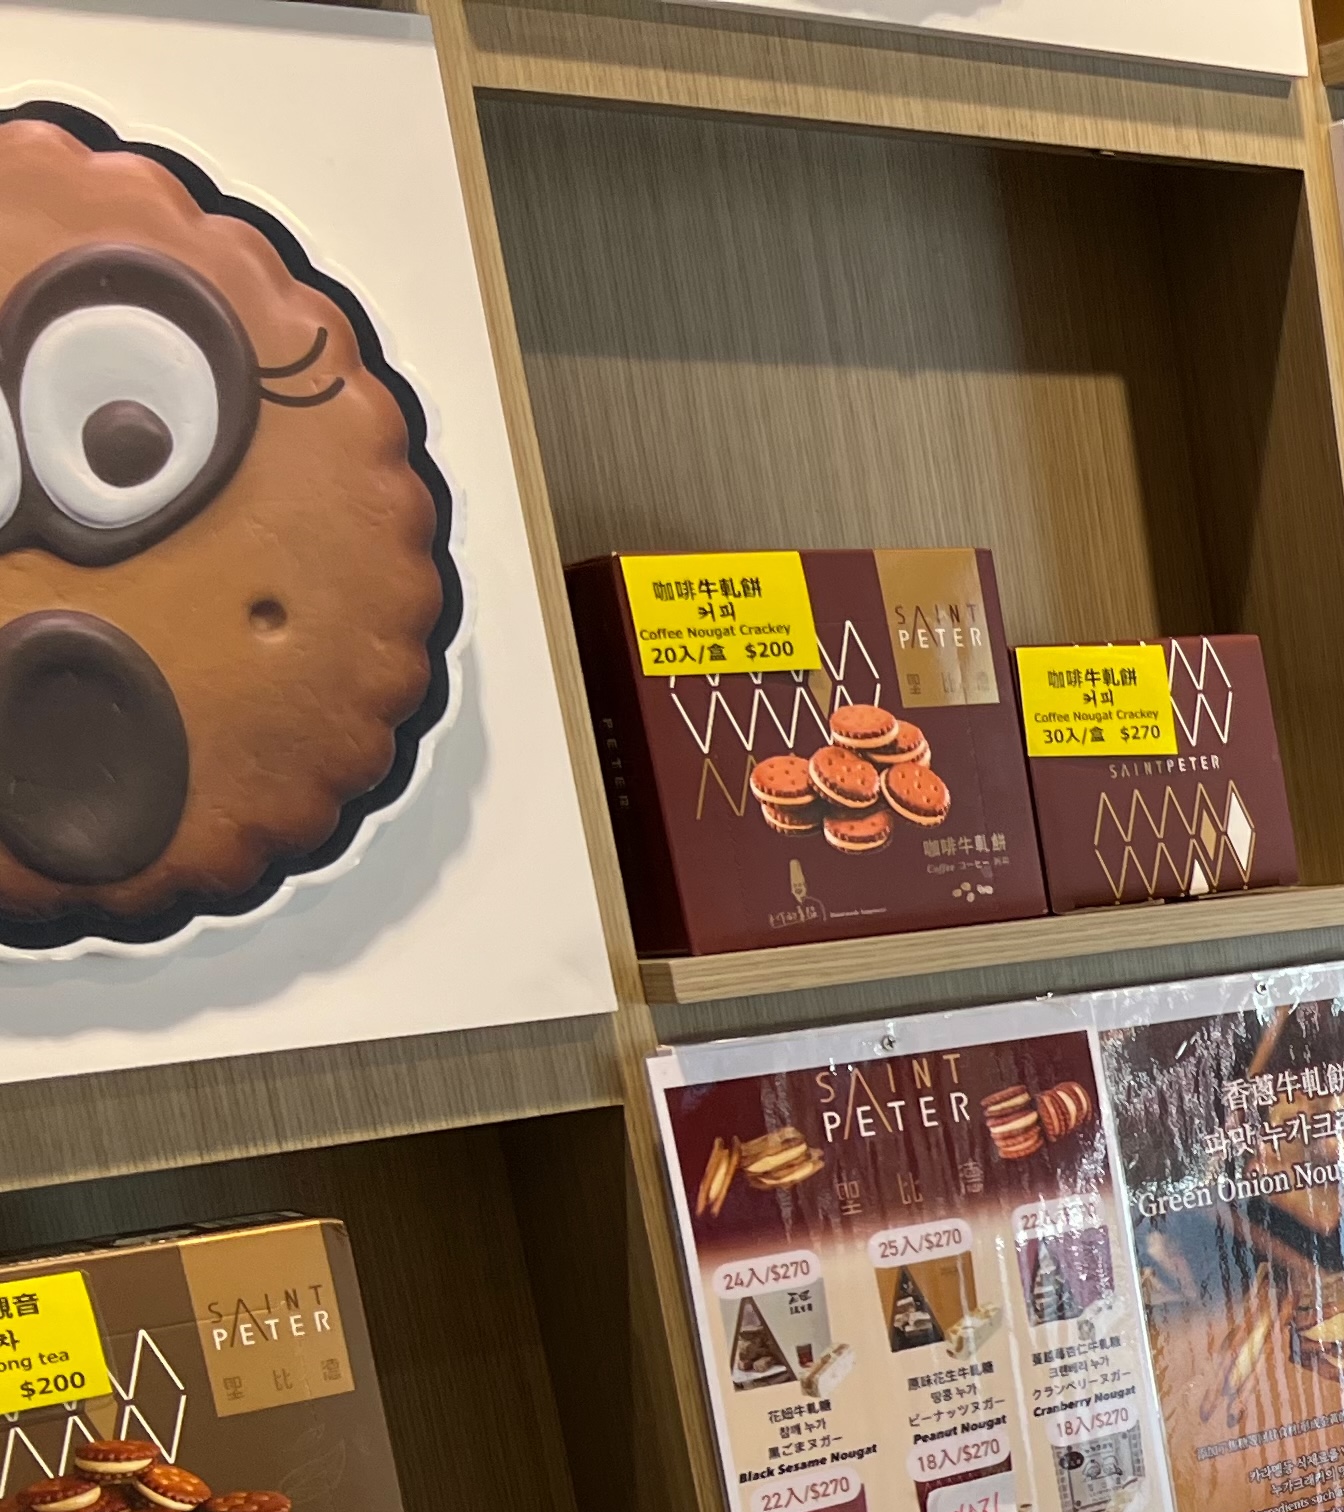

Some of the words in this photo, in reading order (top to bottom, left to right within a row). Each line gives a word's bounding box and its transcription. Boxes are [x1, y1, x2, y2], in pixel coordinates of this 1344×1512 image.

[653, 577, 762, 602] 咖啡牛軋餅
[640, 626, 683, 641] Coffee
[687, 624, 735, 640] Nougat
[740, 623, 791, 638] Crackey
[900, 627, 982, 649] PETER
[652, 644, 727, 664] 20入/盒
[746, 640, 794, 660] $200
[1047, 667, 1137, 688] 咖啡牛軋餅
[1034, 712, 1069, 724] Coffee
[1073, 710, 1113, 722] Nougat
[1116, 709, 1159, 721] Crackey
[1044, 726, 1106, 745] 30入/盒
[1120, 725, 1160, 741] $270
[603, 718, 629, 807] PETER
[823, 1092, 970, 1142] PETER
[1137, 1185, 1214, 1218] Green
[1217, 1171, 1290, 1202] Onion
[878, 1228, 963, 1258] 25入/$270
[723, 1259, 811, 1291] 24入/$270
[213, 1310, 331, 1351] PETER
[39, 1348, 70, 1365] tea
[20, 1371, 86, 1399] $200
[1033, 1397, 1092, 1418] Cranberry
[1094, 1385, 1136, 1404] Nougat
[913, 1425, 957, 1445] Peanut
[960, 1414, 1007, 1436] Nougat
[1056, 1406, 1129, 1437] 18入/$270
[739, 1466, 775, 1484] Black
[778, 1457, 827, 1475] Sesame
[830, 1443, 878, 1463] Nougat
[918, 1438, 1001, 1473] 18入/$270
[762, 1476, 850, 1511] 22入/$270
[1311, 1490, 1335, 1506] such
